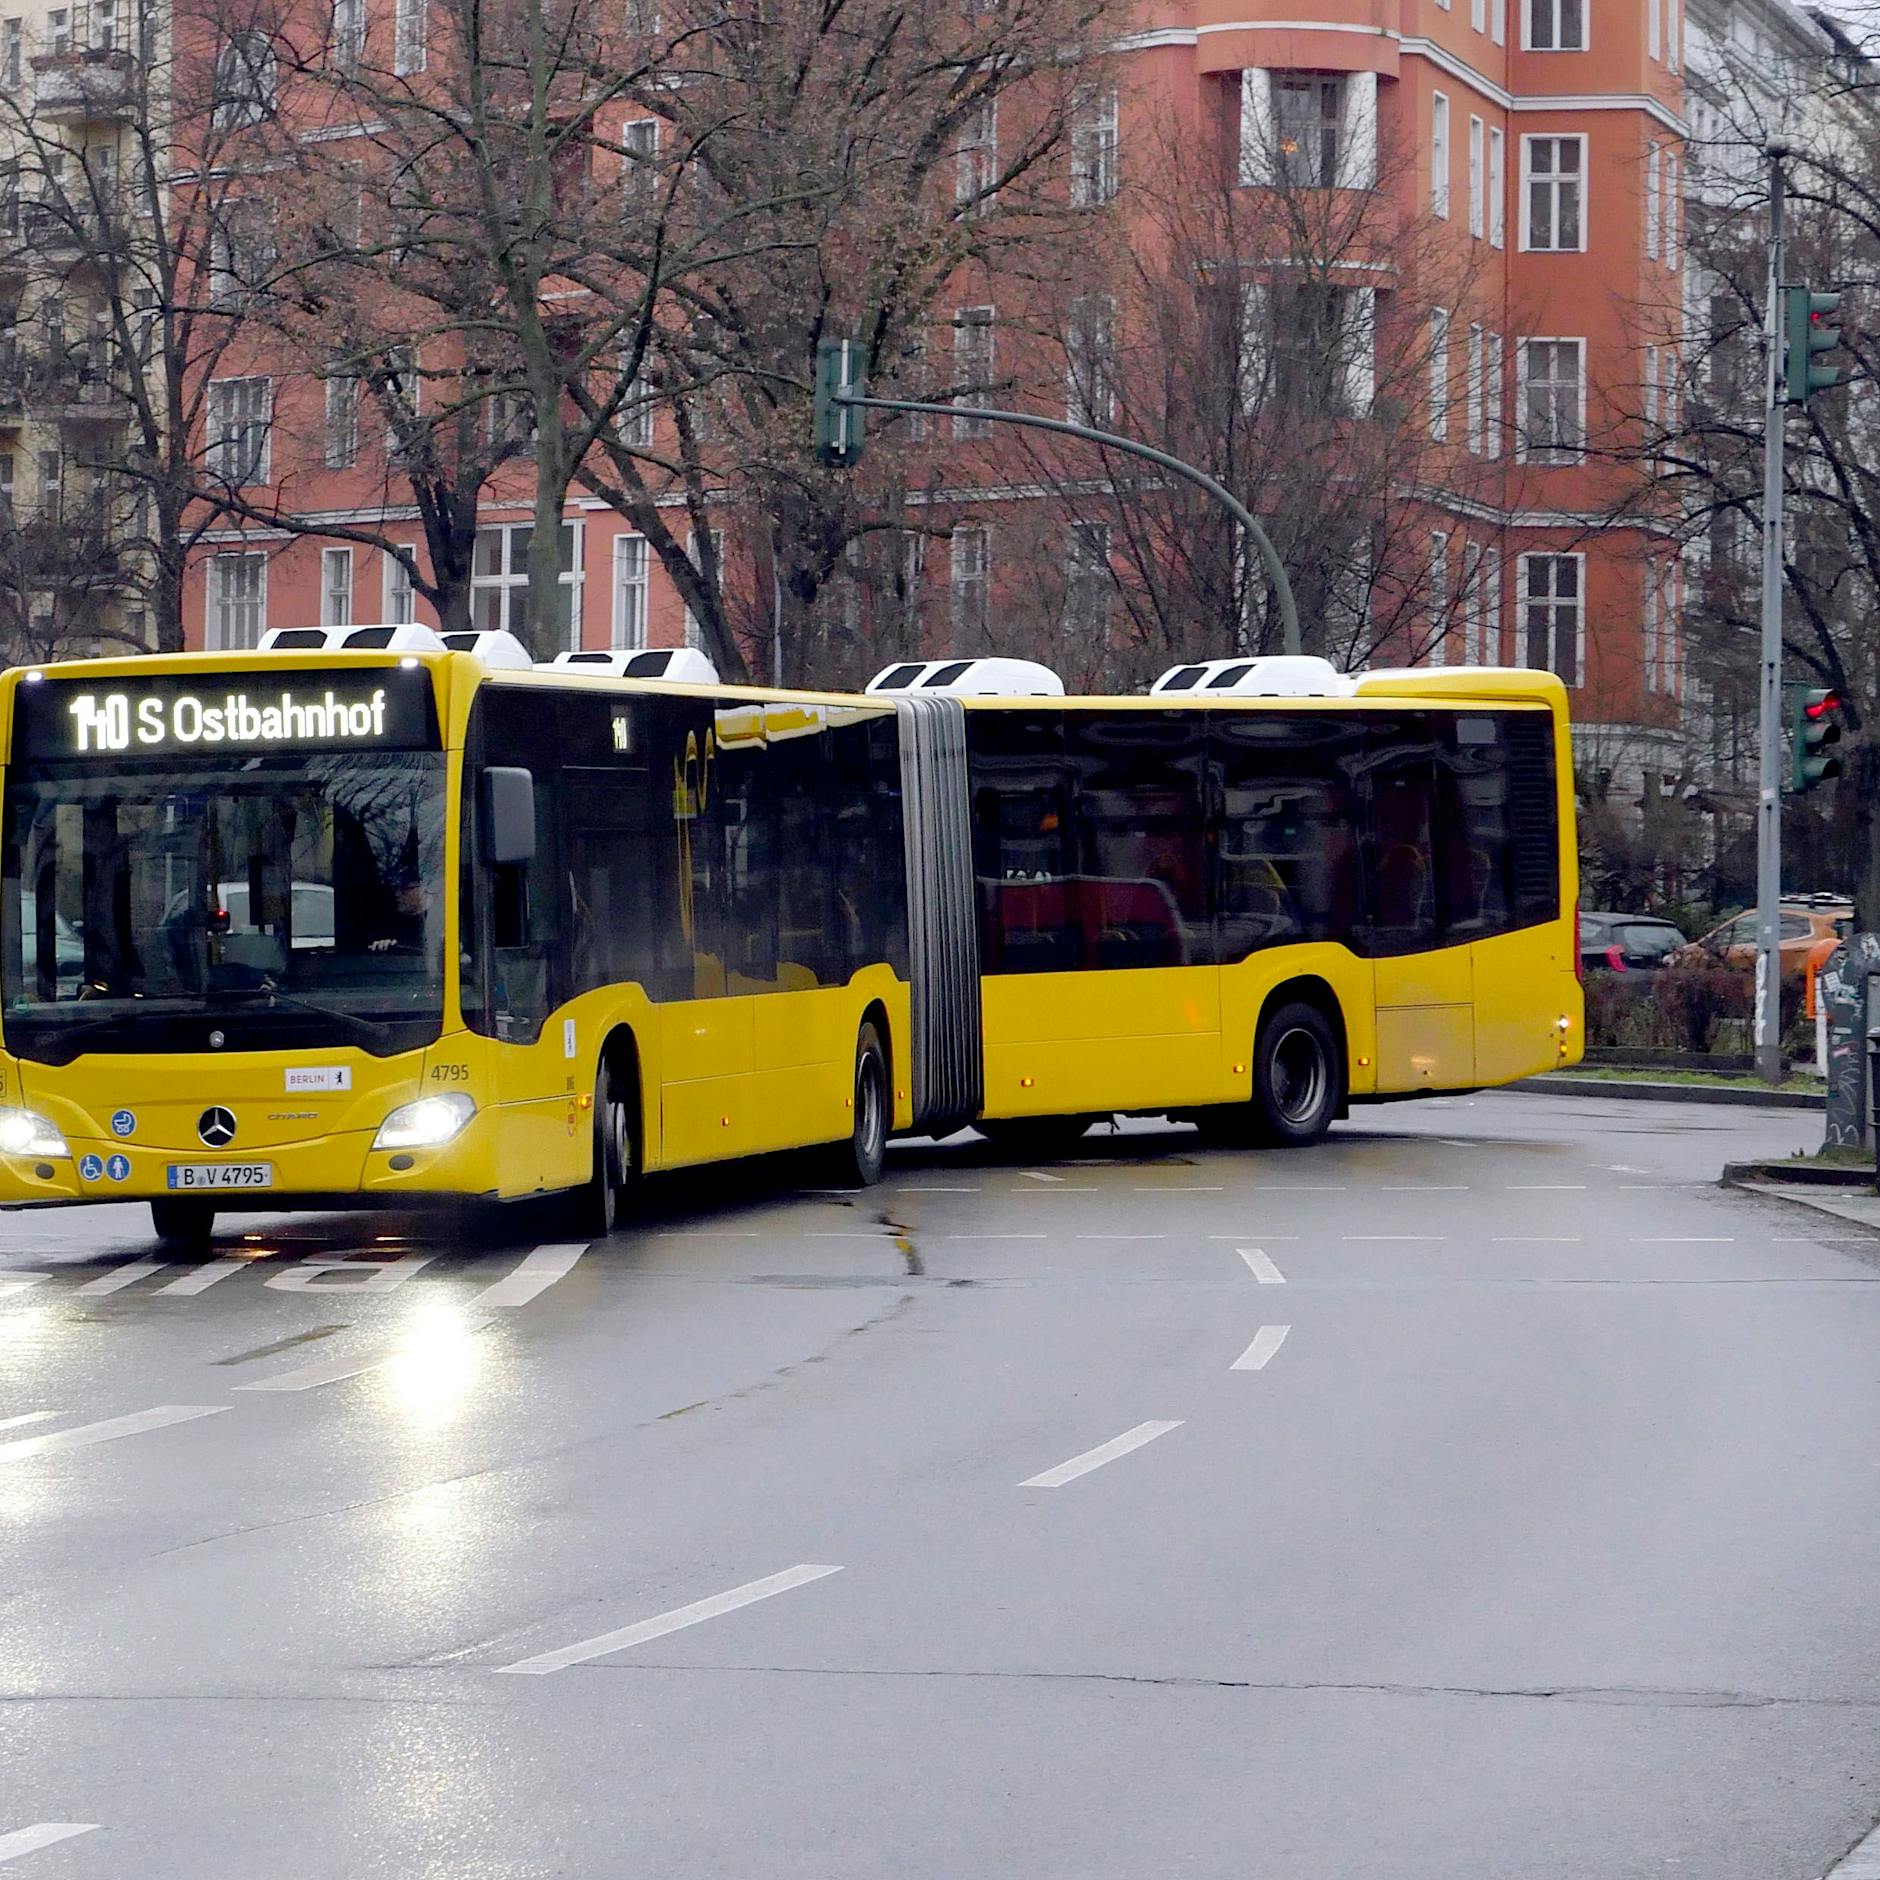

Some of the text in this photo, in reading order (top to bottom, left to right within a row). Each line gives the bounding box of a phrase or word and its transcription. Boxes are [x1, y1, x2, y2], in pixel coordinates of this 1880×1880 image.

[137, 698, 166, 743] S
[173, 689, 386, 742] Ostbahnhof
[289, 1074, 325, 1085] BERLIN
[431, 1064, 469, 1081] 4795
[184, 1166, 264, 1185] B V 4795
